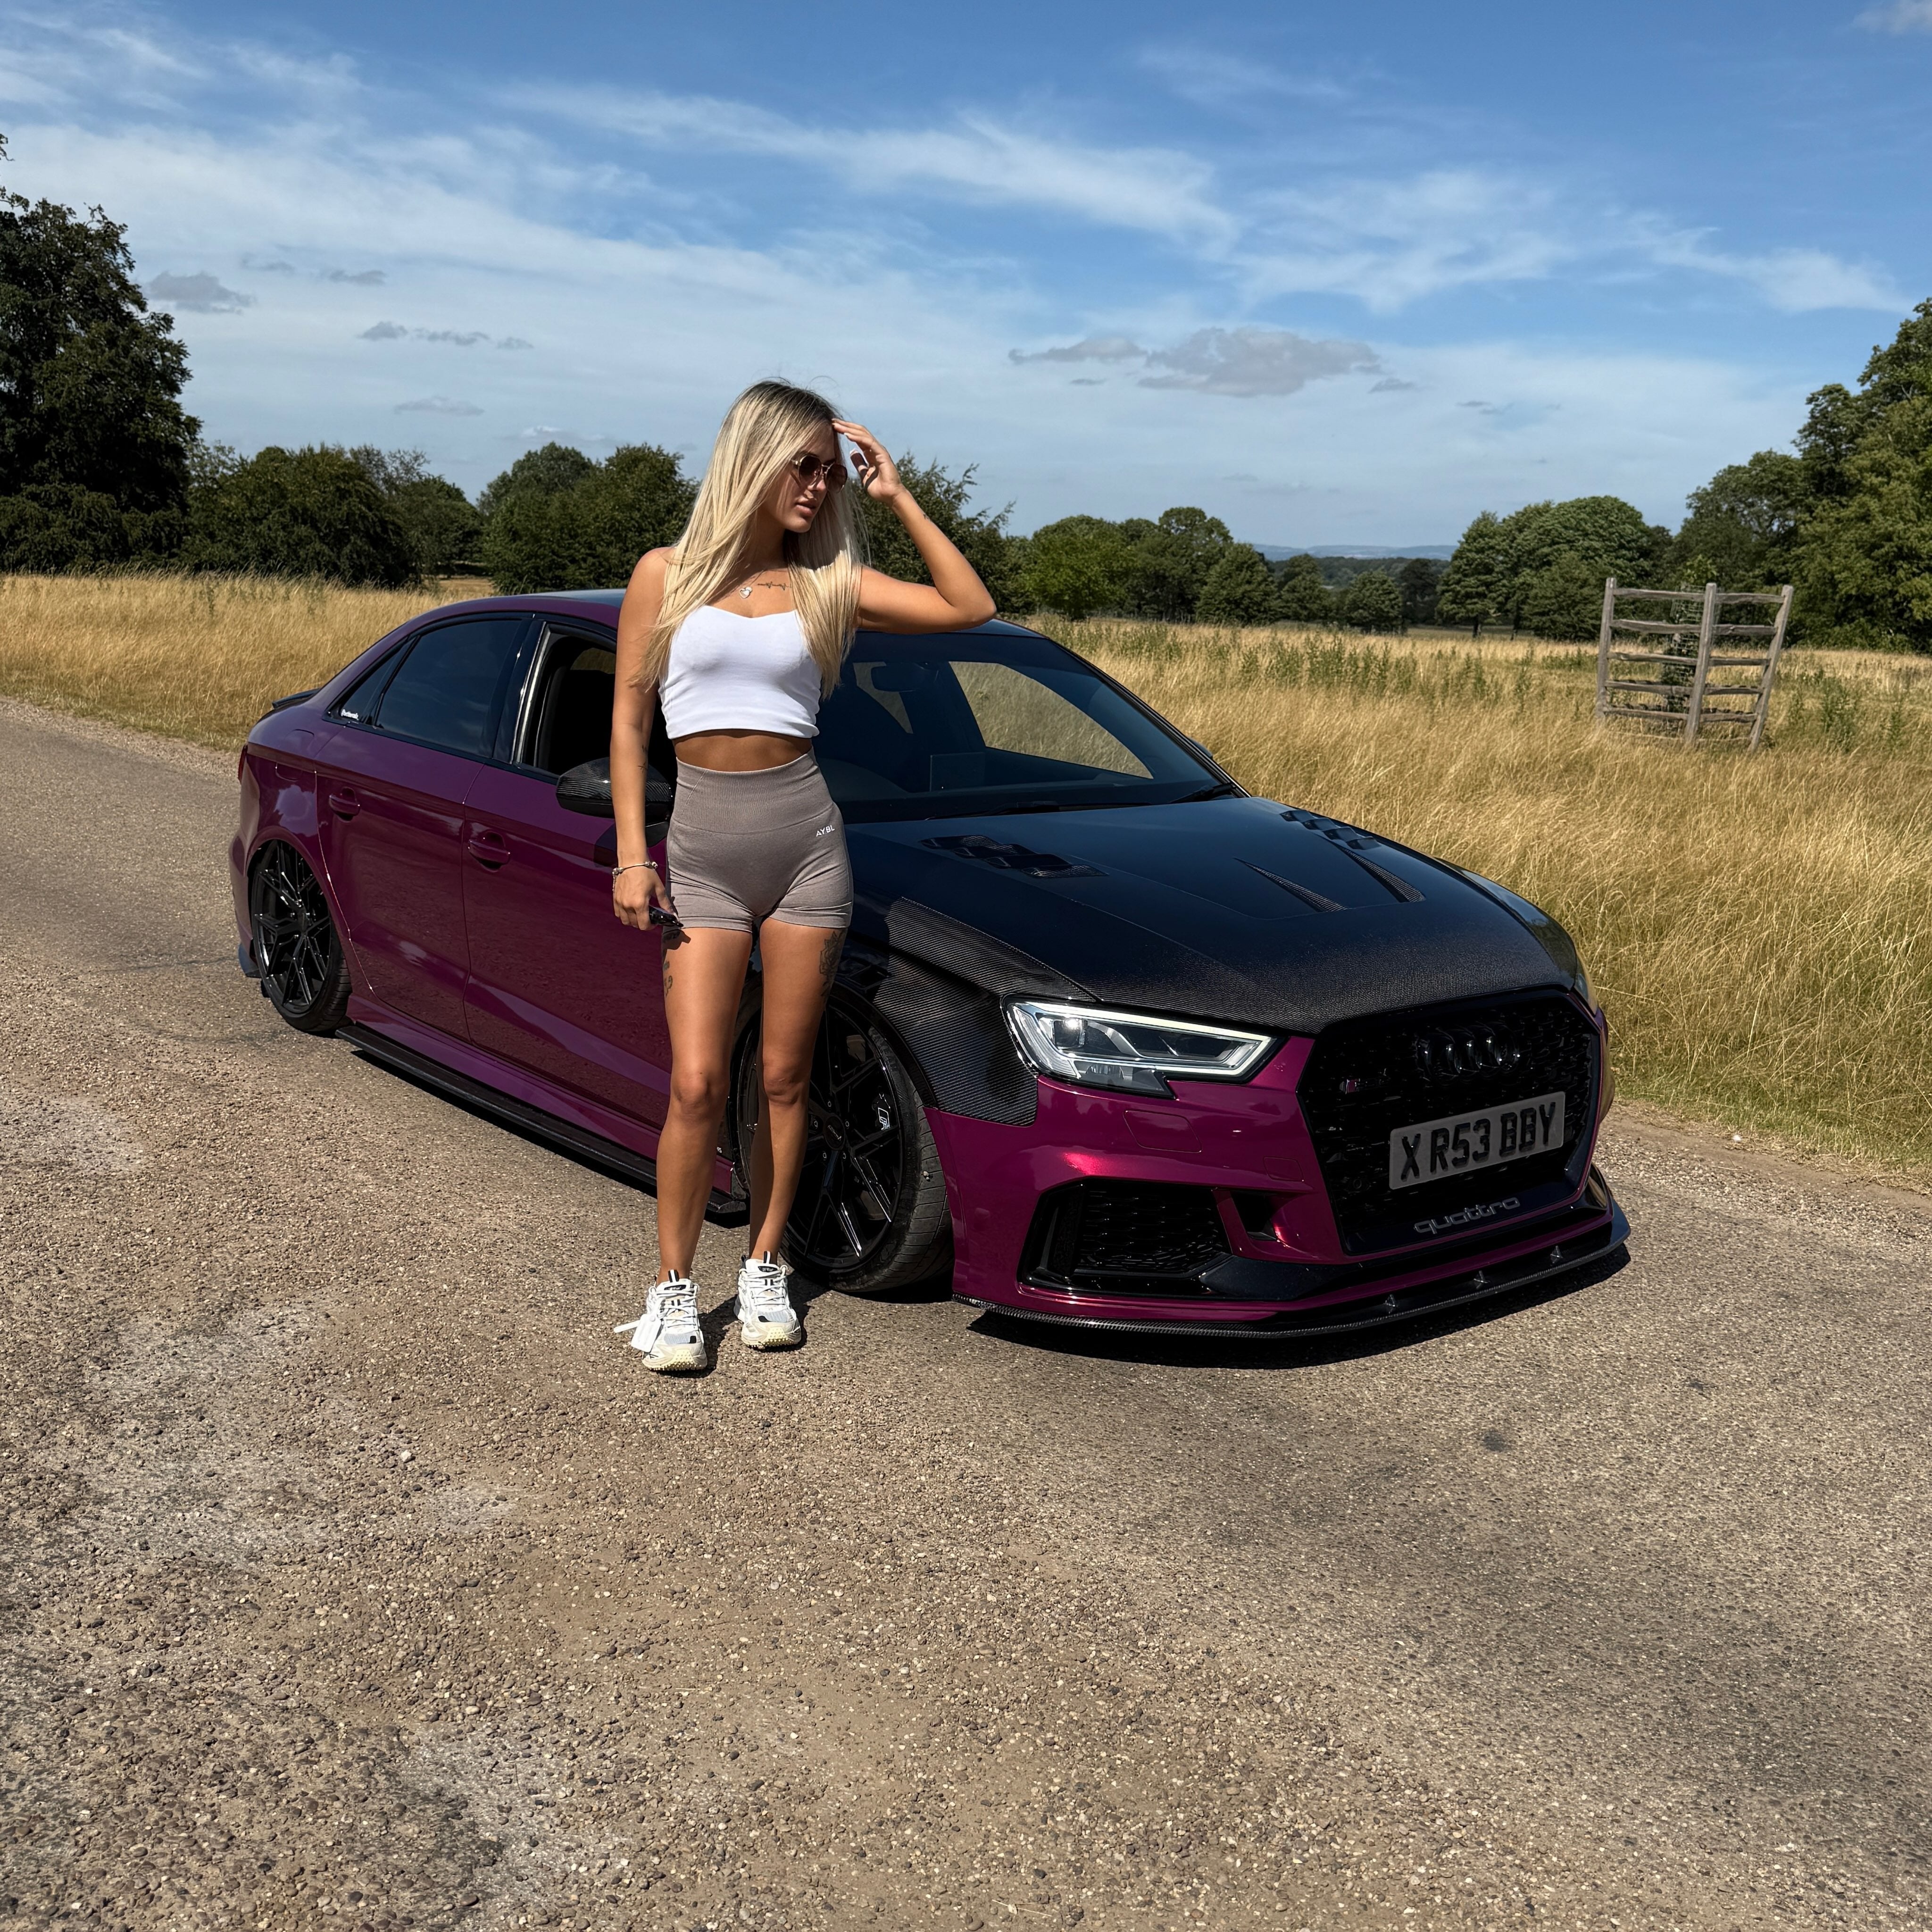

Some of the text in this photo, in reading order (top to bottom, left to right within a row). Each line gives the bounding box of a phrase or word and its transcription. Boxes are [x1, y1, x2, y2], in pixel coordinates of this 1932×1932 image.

[816, 825, 835, 837] AYBL
[1401, 1102, 1556, 1181] X R53 BBY
[1414, 1197, 1520, 1234] quattro
